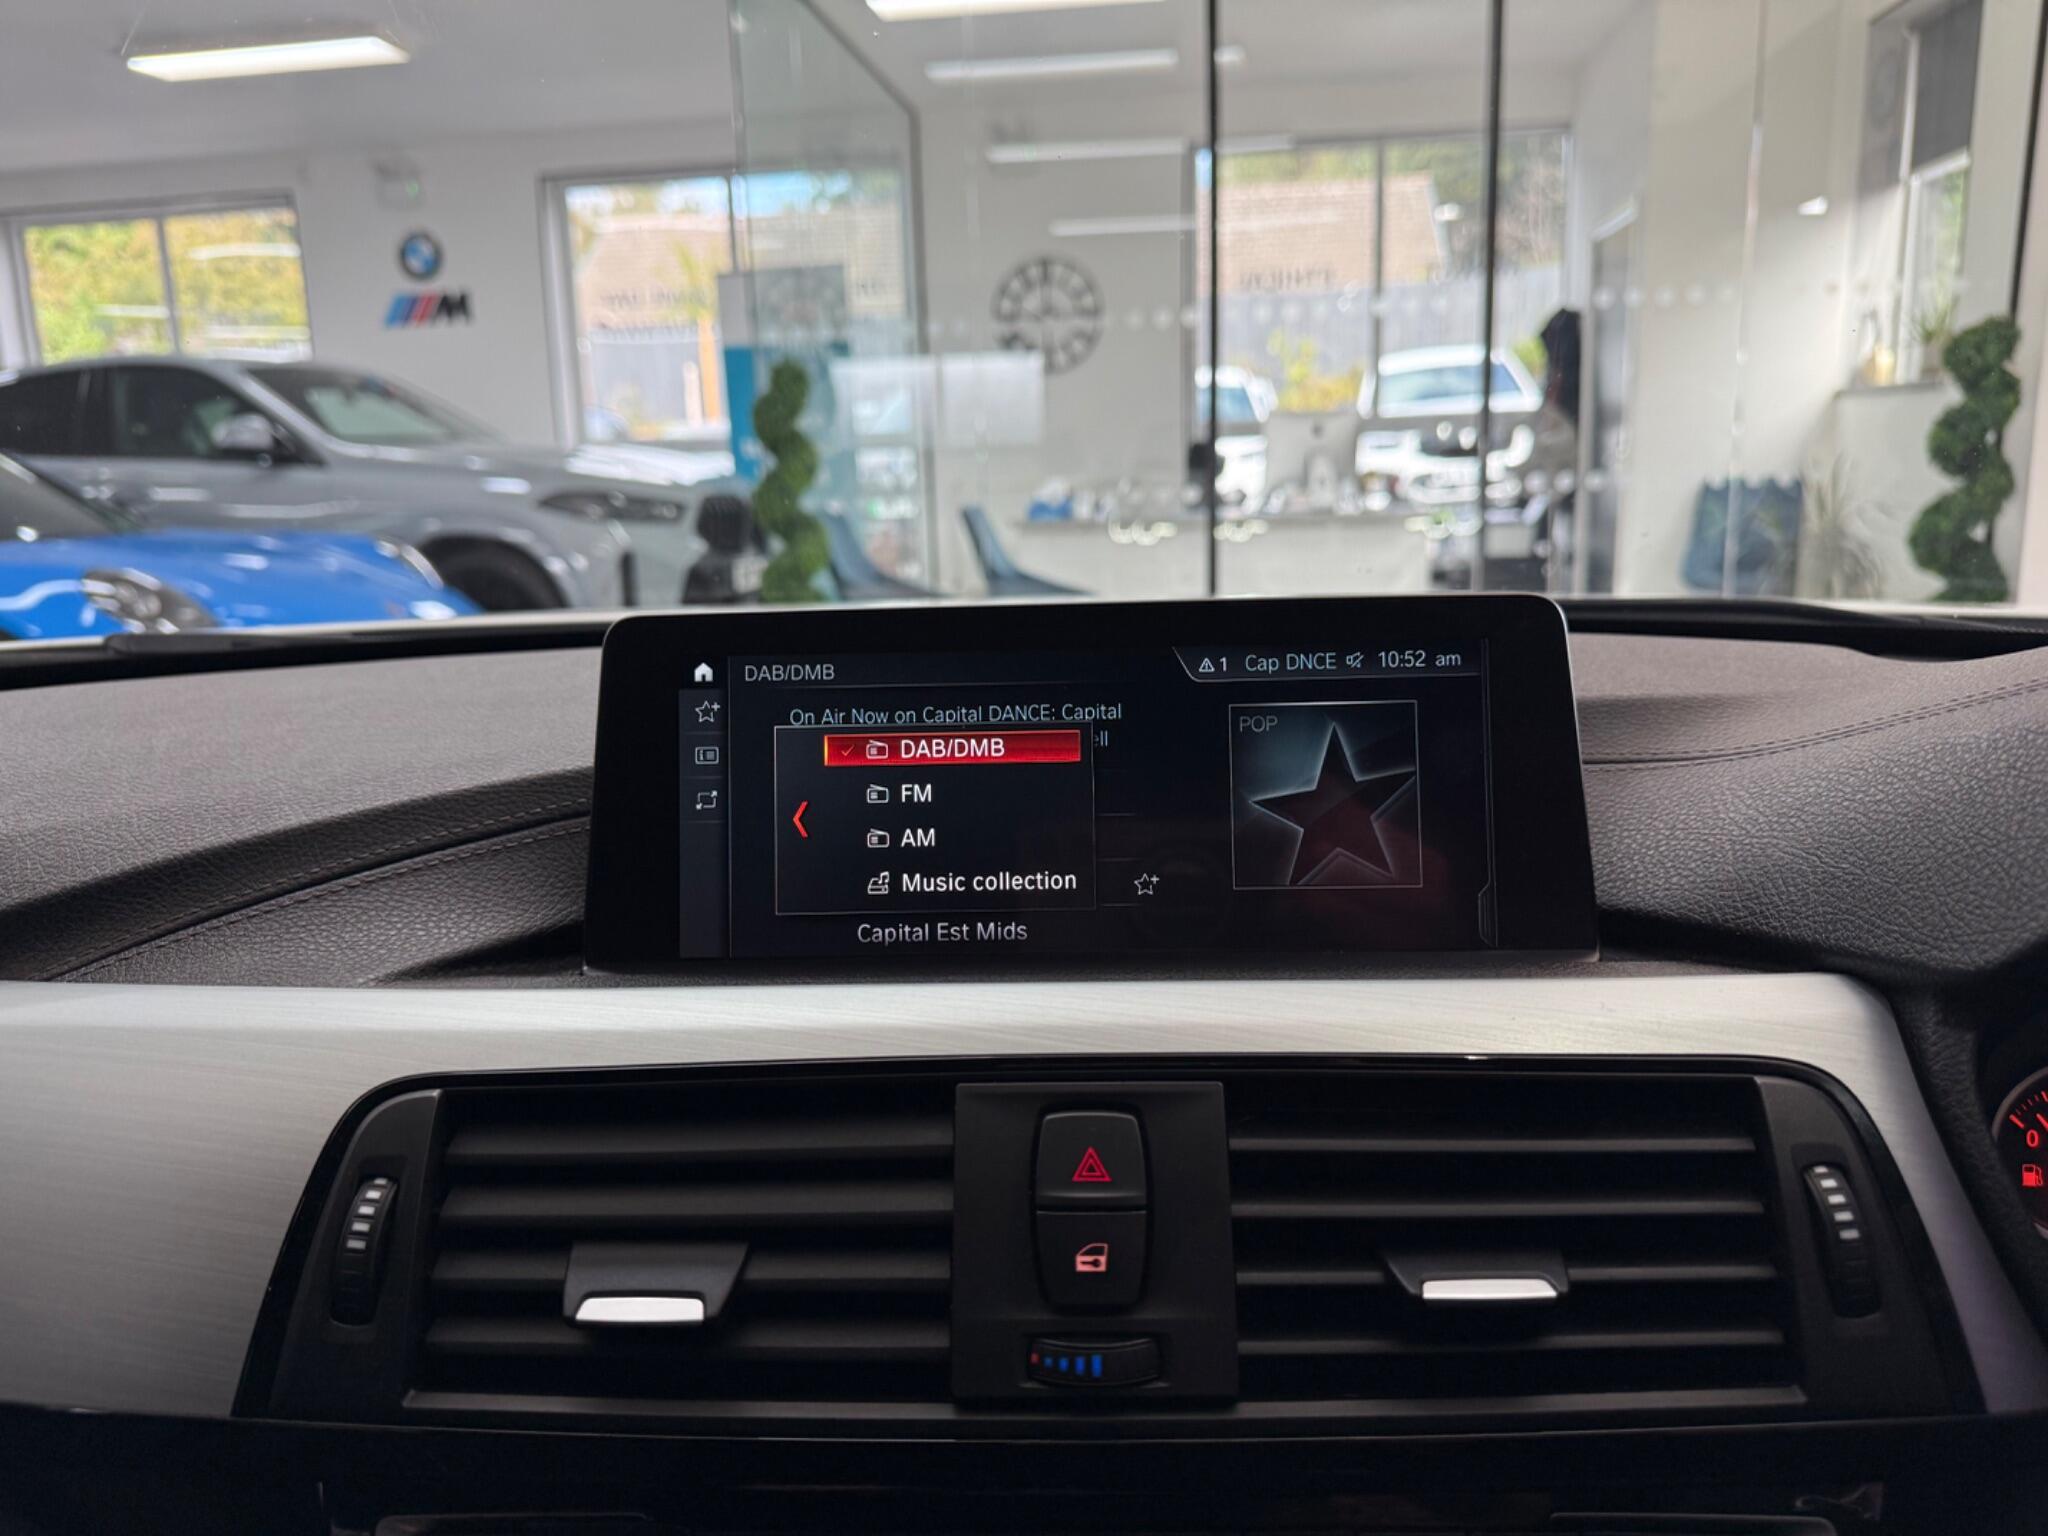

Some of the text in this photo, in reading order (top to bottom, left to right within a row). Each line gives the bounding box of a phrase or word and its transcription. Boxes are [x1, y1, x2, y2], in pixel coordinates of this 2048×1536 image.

[1219, 652, 1337, 675] 1 Cap DNCE
[1378, 650, 1461, 668] 10:52 am
[744, 663, 835, 682] DAB/DMB
[789, 703, 1122, 726] On Air Now on Capital DANCE: Capital
[1239, 716, 1278, 732] POP
[901, 738, 1005, 758] DAB/DMB
[901, 784, 932, 803] FM
[901, 828, 936, 847] AM
[902, 871, 1077, 893] Music collection
[857, 921, 1028, 946] Capital Est Mids
[2026, 1129, 2040, 1148] 0
